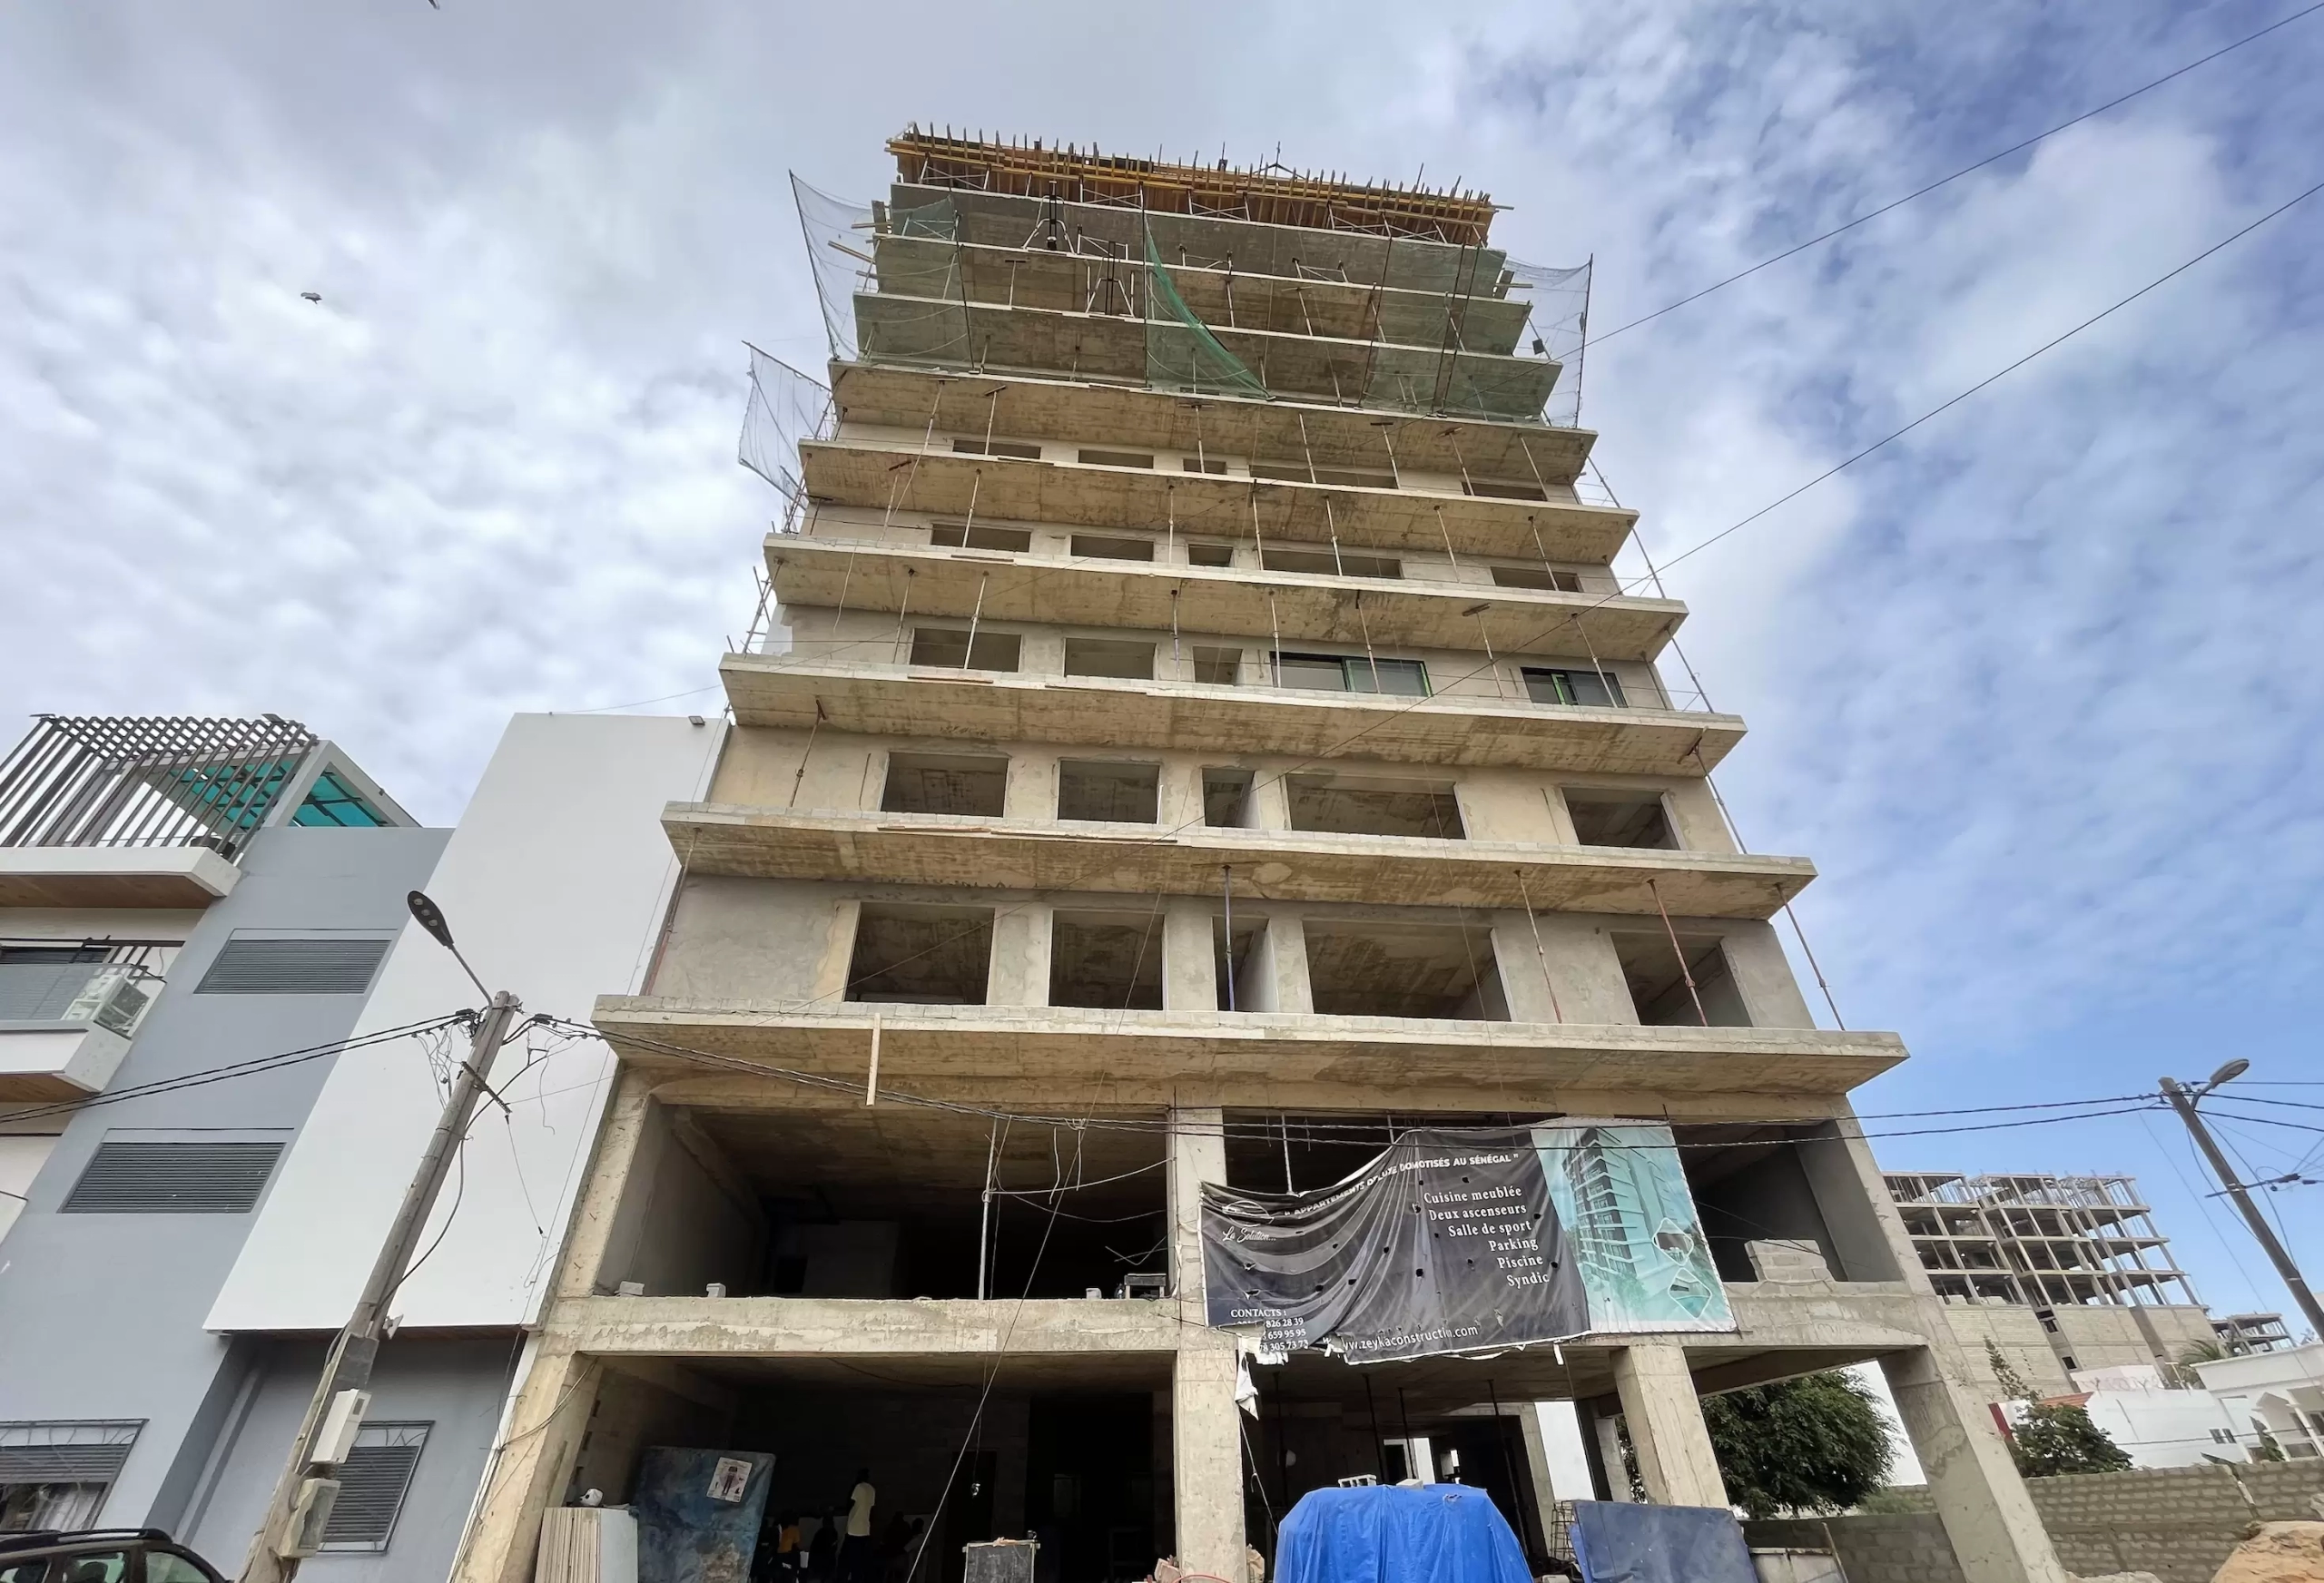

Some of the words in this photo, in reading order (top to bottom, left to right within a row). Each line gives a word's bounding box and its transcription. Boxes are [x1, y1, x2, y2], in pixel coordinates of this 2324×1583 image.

[1294, 1181, 1365, 1214] APPARTEMENTS
[1400, 1157, 1451, 1172] DOMOTISÉS
[1453, 1157, 1467, 1166] AU
[1469, 1154, 1512, 1165] SÉNÉGAL
[1423, 1191, 1468, 1204] Cuisine
[1471, 1185, 1522, 1201] meublée
[1428, 1209, 1460, 1221] Deux
[1462, 1204, 1527, 1218] ascenseurs
[1448, 1224, 1479, 1237] Salle
[1482, 1223, 1496, 1234] de
[1499, 1220, 1531, 1235] sport
[1488, 1238, 1539, 1252] Parking
[1497, 1255, 1543, 1269] Piscine
[1507, 1272, 1550, 1289] Syndic
[1230, 1308, 1282, 1318] CONTACTS
[1265, 1319, 1281, 1328] 826
[1282, 1318, 1293, 1327] 28
[1294, 1317, 1304, 1326] 39
[1267, 1331, 1283, 1340] 659
[1284, 1330, 1295, 1338] 95
[1295, 1328, 1306, 1337] 95
[1269, 1342, 1285, 1352] 305
[1285, 1341, 1297, 1349] 73
